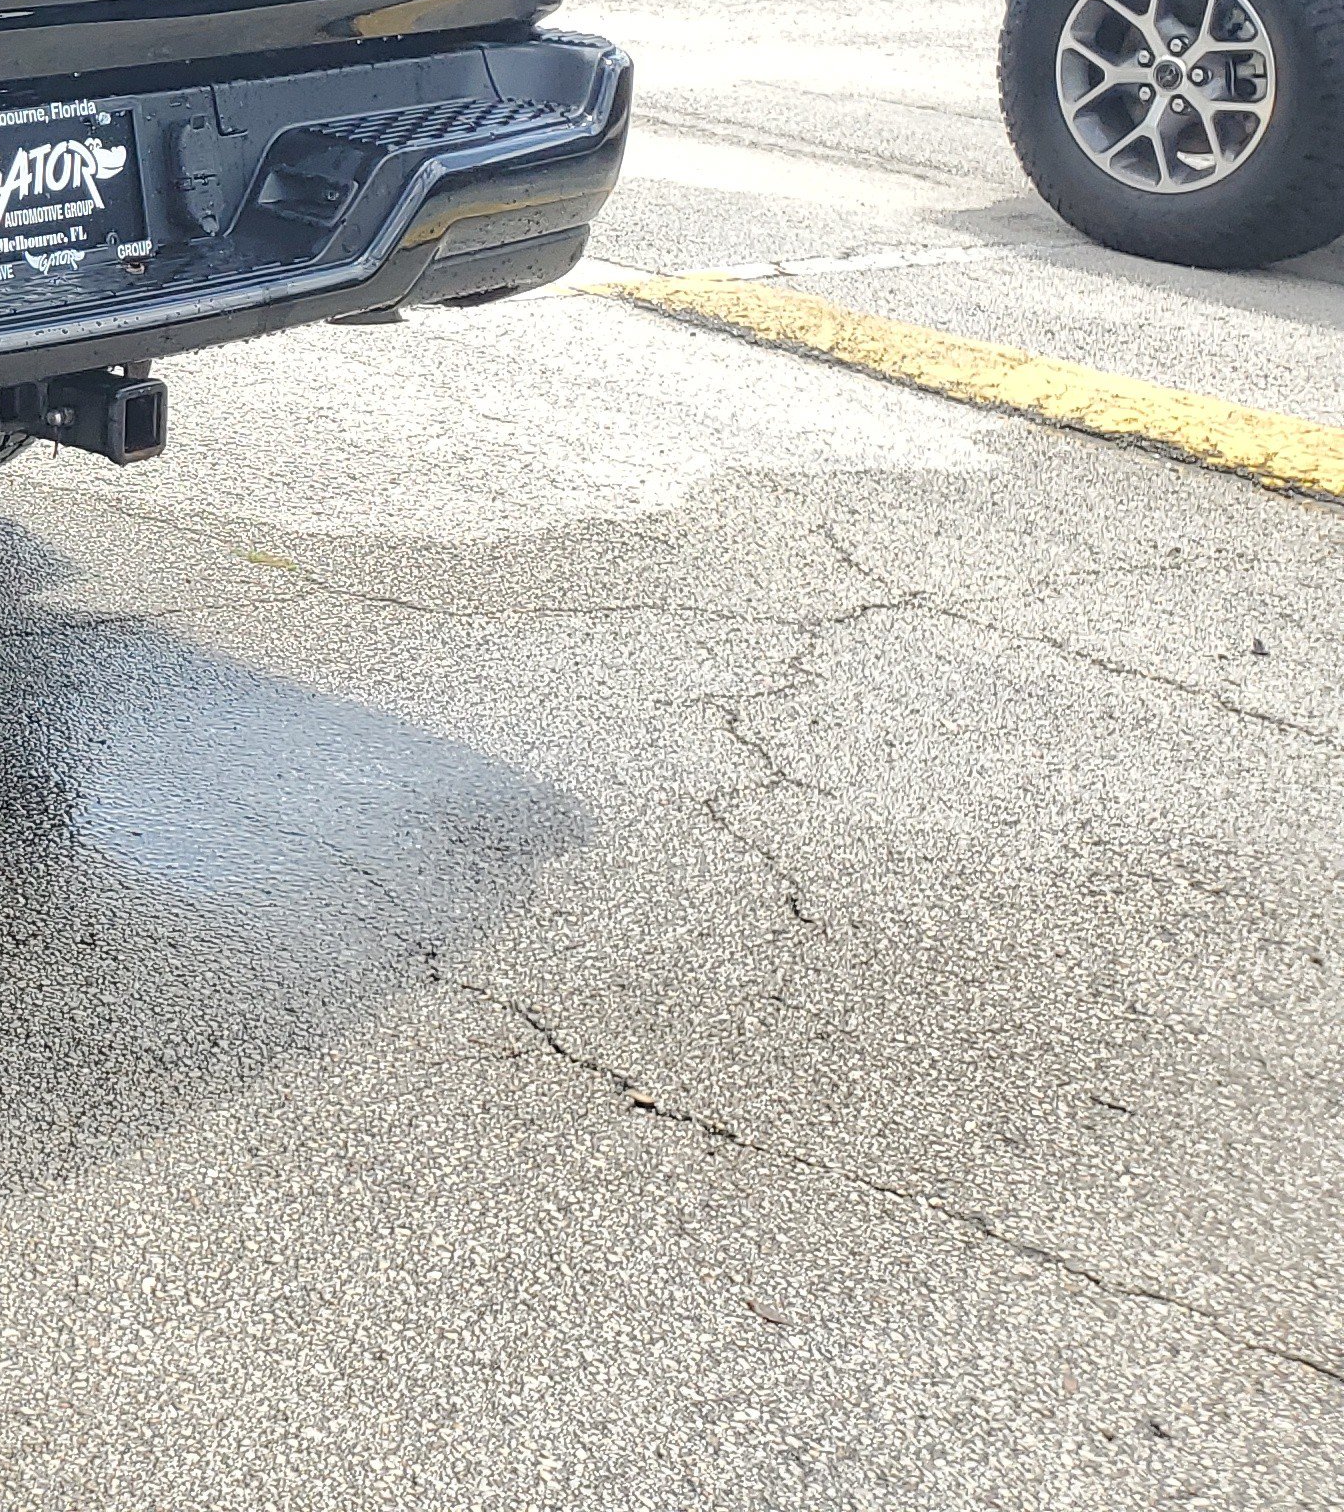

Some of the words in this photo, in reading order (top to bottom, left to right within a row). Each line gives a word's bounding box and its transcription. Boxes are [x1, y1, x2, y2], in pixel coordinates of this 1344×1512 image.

[51, 99, 97, 119] Florida
[5, 203, 63, 228] AUTOMOTIVE
[64, 199, 95, 220] GROUP
[70, 225, 87, 242] FL
[38, 249, 80, 275] GATOR
[117, 240, 154, 260] GROUP
